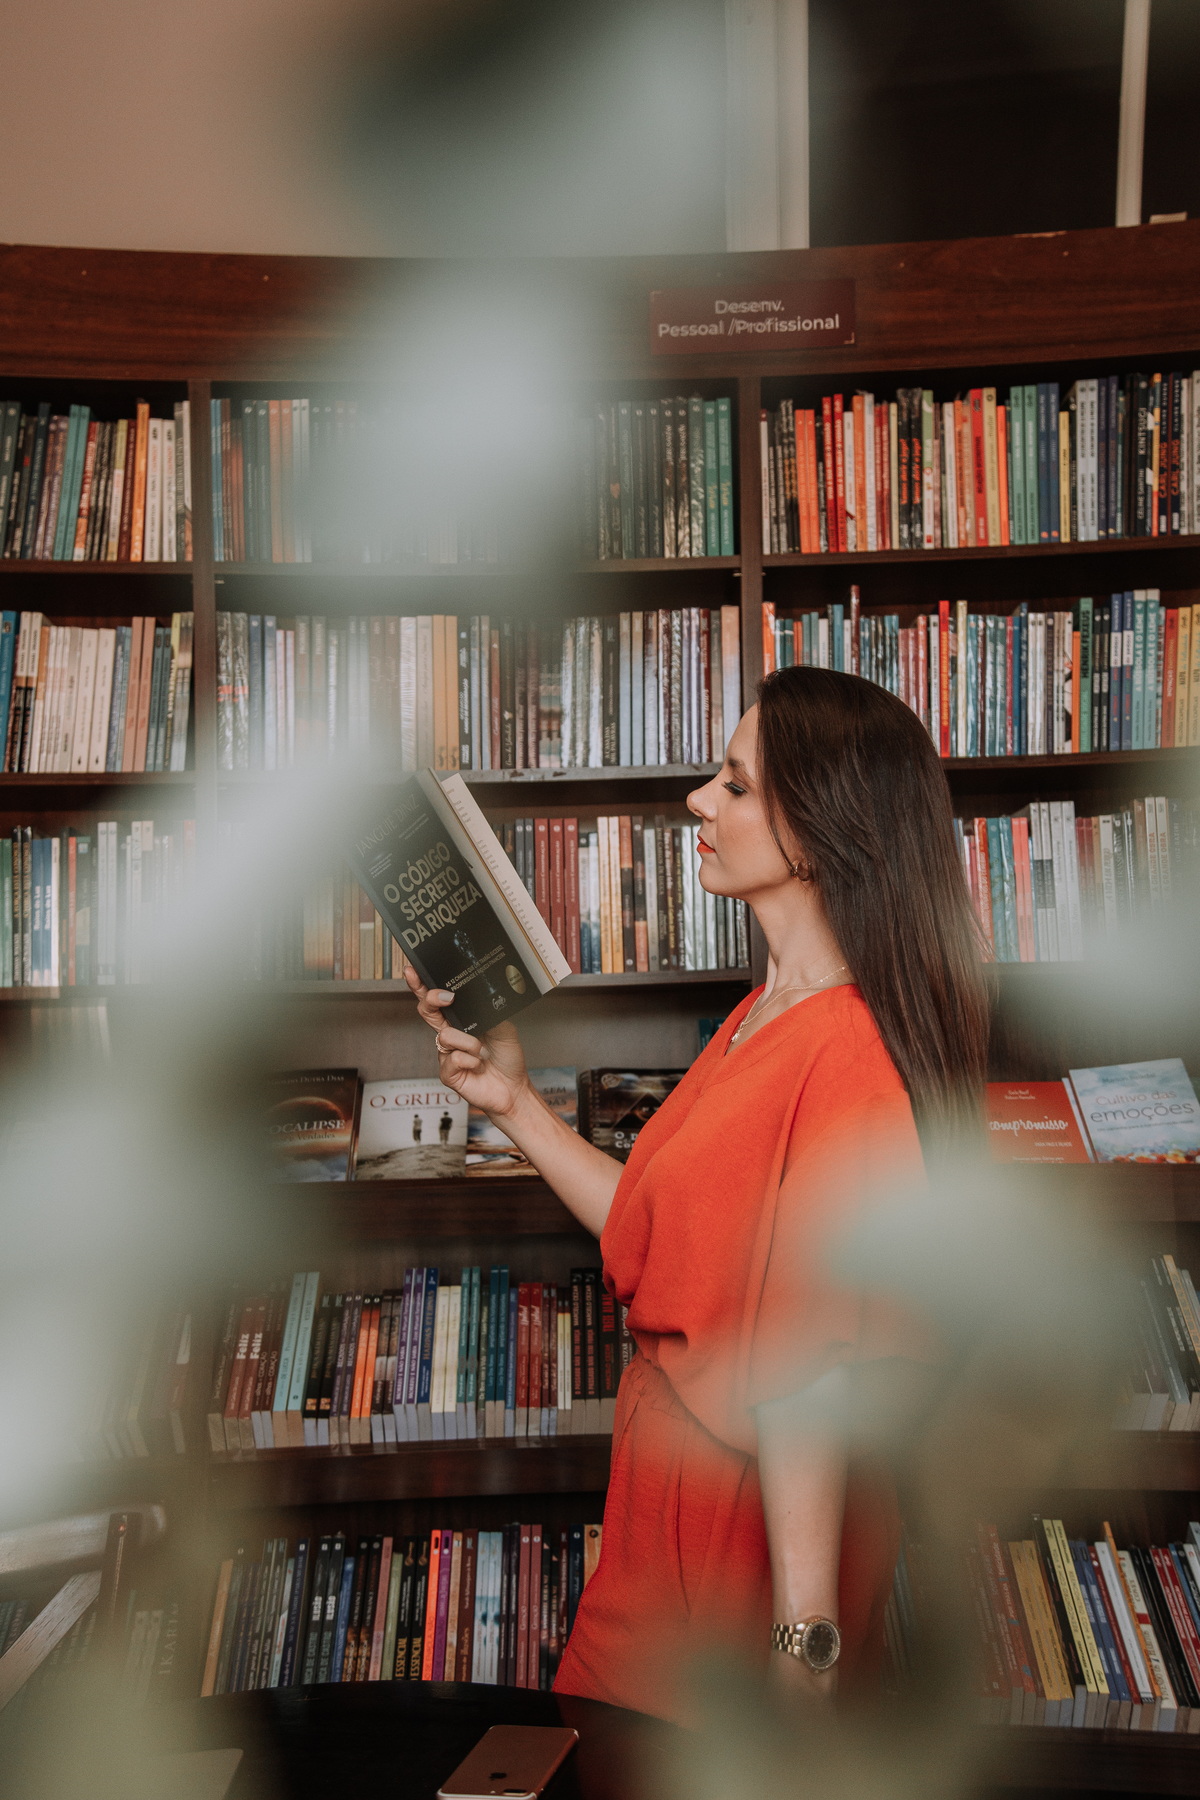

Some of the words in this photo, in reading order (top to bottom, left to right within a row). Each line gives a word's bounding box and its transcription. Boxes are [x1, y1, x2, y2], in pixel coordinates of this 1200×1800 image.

[715, 300, 785, 314] Desenv.
[658, 320, 724, 337] Pessoal
[1138, 407, 1147, 455] KINTSUGI
[900, 438, 908, 456] jogo?
[912, 438, 922, 456] jogo?
[900, 464, 908, 481] abrir
[913, 464, 921, 481] abrir
[913, 482, 921, 504] Vamos
[1081, 610, 1090, 643] FEXEUS
[1148, 613, 1156, 633] LEME
[1081, 646, 1090, 679] HENRIK
[1133, 650, 1143, 685] BÚSSOLA
[1146, 650, 1155, 685] BÚSSOLA
[383, 884, 400, 903] O
[399, 842, 450, 893] CÓDIGO
[658, 866, 664, 874] DE
[1150, 854, 1159, 885] GRANDE
[1161, 854, 1170, 885] GRANDE
[34, 900, 40, 908] de
[45, 899, 51, 908] de
[400, 866, 460, 921] SECRETO
[401, 921, 432, 949] DA
[424, 881, 482, 933] RIQUEZA
[370, 1095, 386, 1108] O
[395, 1092, 461, 1106] GRITO
[1096, 1094, 1147, 1106] Cultivo
[1151, 1091, 1177, 1100] das
[1091, 1102, 1194, 1122] emoções
[990, 1116, 1068, 1137] compromisso
[424, 1290, 434, 1325] ETERNAS
[602, 1294, 613, 1313] ALMAS
[603, 1315, 615, 1332] TREZE
[236, 1333, 249, 1359] Feliz
[250, 1333, 263, 1359] Feliz
[423, 1328, 432, 1360] HARPAS
[574, 1329, 582, 1344] FORÇA
[587, 1329, 595, 1344] FORÇA
[992, 1542, 1005, 1576] felicidade
[1069, 1570, 1084, 1615] REENCONTRO
[1083, 1617, 1091, 1633] COM
[1165, 1585, 1174, 1604] CORAÇÃO
[1175, 1585, 1184, 1603] CORAÇÃO
[311, 1595, 322, 1621] ILUSÃO
[326, 1595, 336, 1620] ILUSÃO
[1063, 1587, 1079, 1632] REENCONTRO
[1171, 1605, 1178, 1615] DO
[1182, 1604, 1188, 1615] DO
[1176, 1617, 1186, 1639] MINDSET
[1186, 1616, 1196, 1638] MINDSET
[395, 1637, 407, 1677] ESSENCIAL
[410, 1636, 422, 1677] ESSENCIAL
